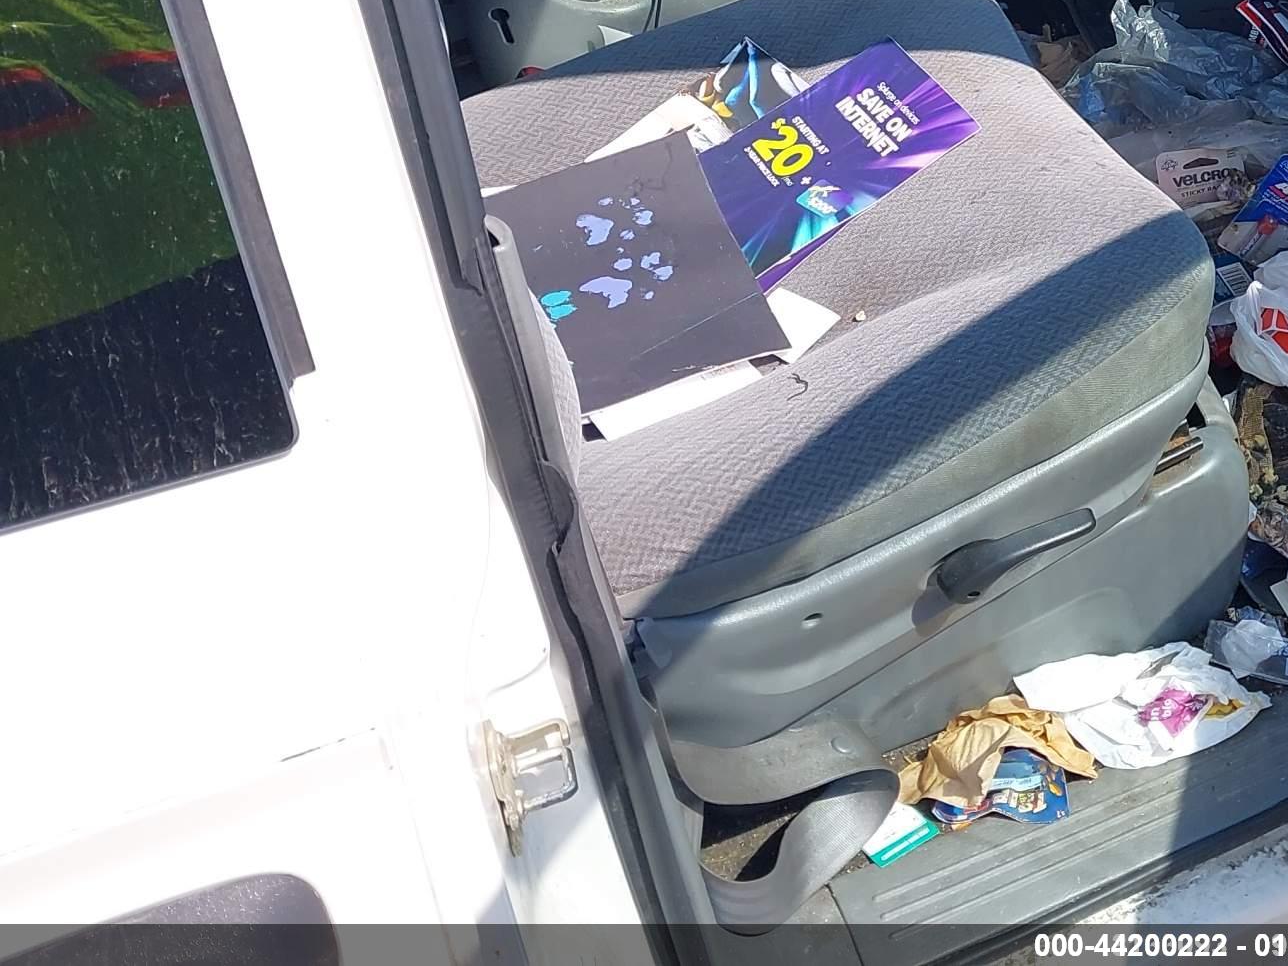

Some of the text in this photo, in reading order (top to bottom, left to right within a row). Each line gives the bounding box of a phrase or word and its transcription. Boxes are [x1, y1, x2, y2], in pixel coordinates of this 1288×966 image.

[856, 88, 912, 143] SAVE ON
[877, 82, 896, 102] Splurge
[900, 105, 920, 125] devices
[752, 118, 813, 176] $20
[792, 116, 830, 155] STARTING AT
[835, 96, 899, 157] INTERNET
[767, 172, 780, 187] LOCK
[1181, 188, 1206, 198] STICKY
